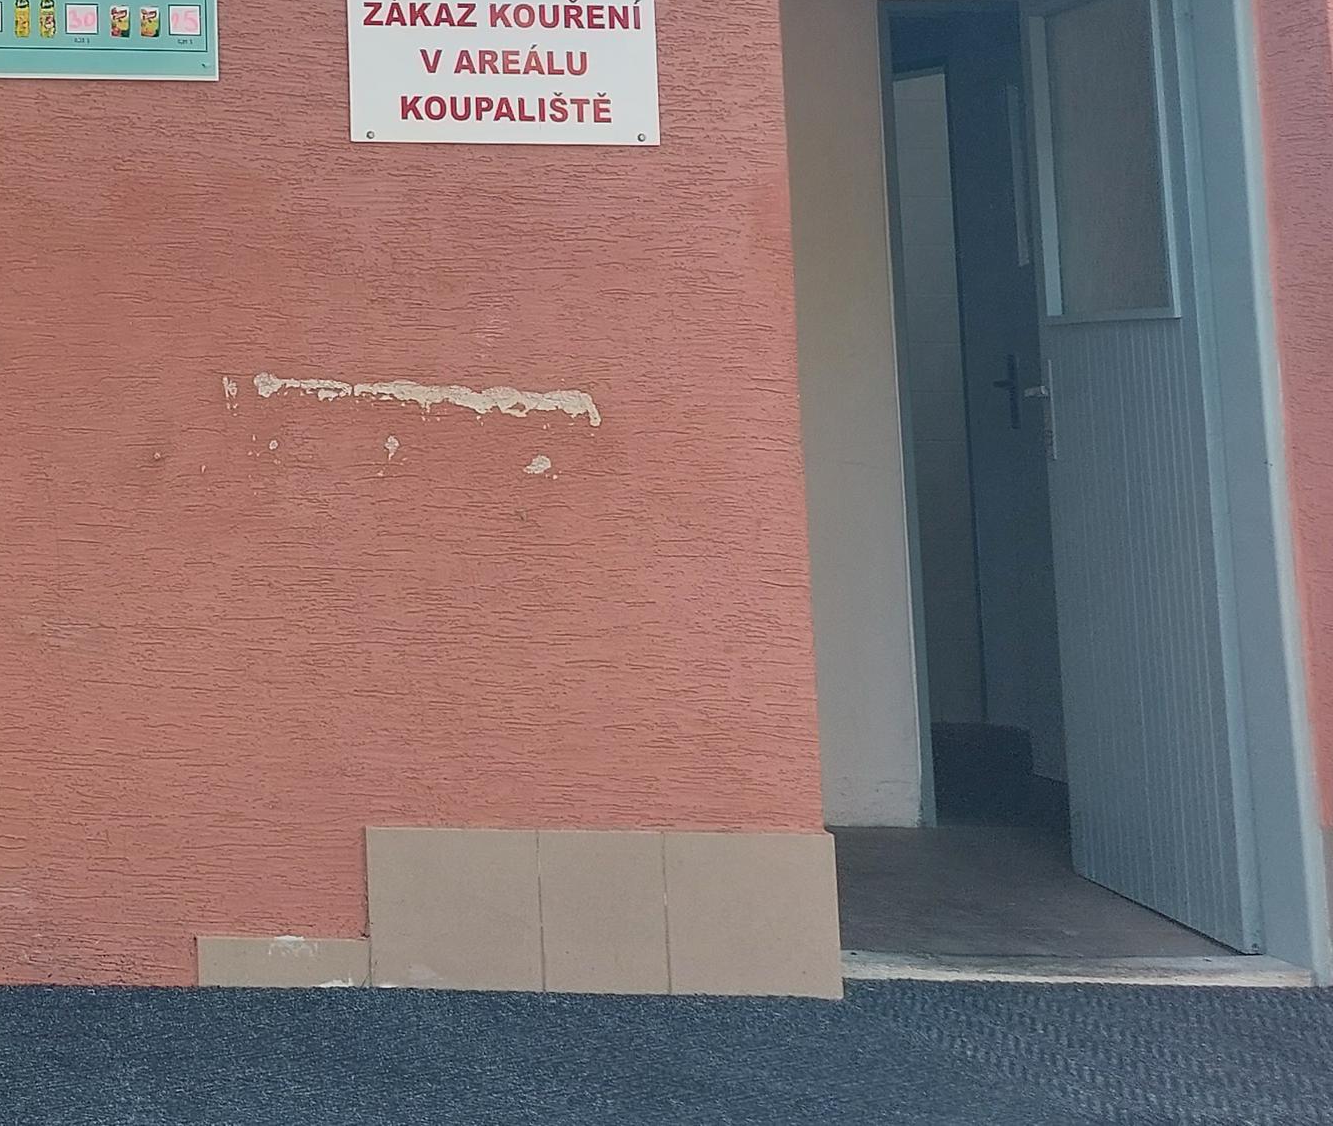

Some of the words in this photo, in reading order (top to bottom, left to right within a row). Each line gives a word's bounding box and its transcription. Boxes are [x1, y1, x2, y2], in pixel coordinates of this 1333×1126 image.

[420, 49, 442, 73] V
[454, 43, 589, 75] AREÁLU
[400, 92, 612, 124] KOUPALIŠTĚ
